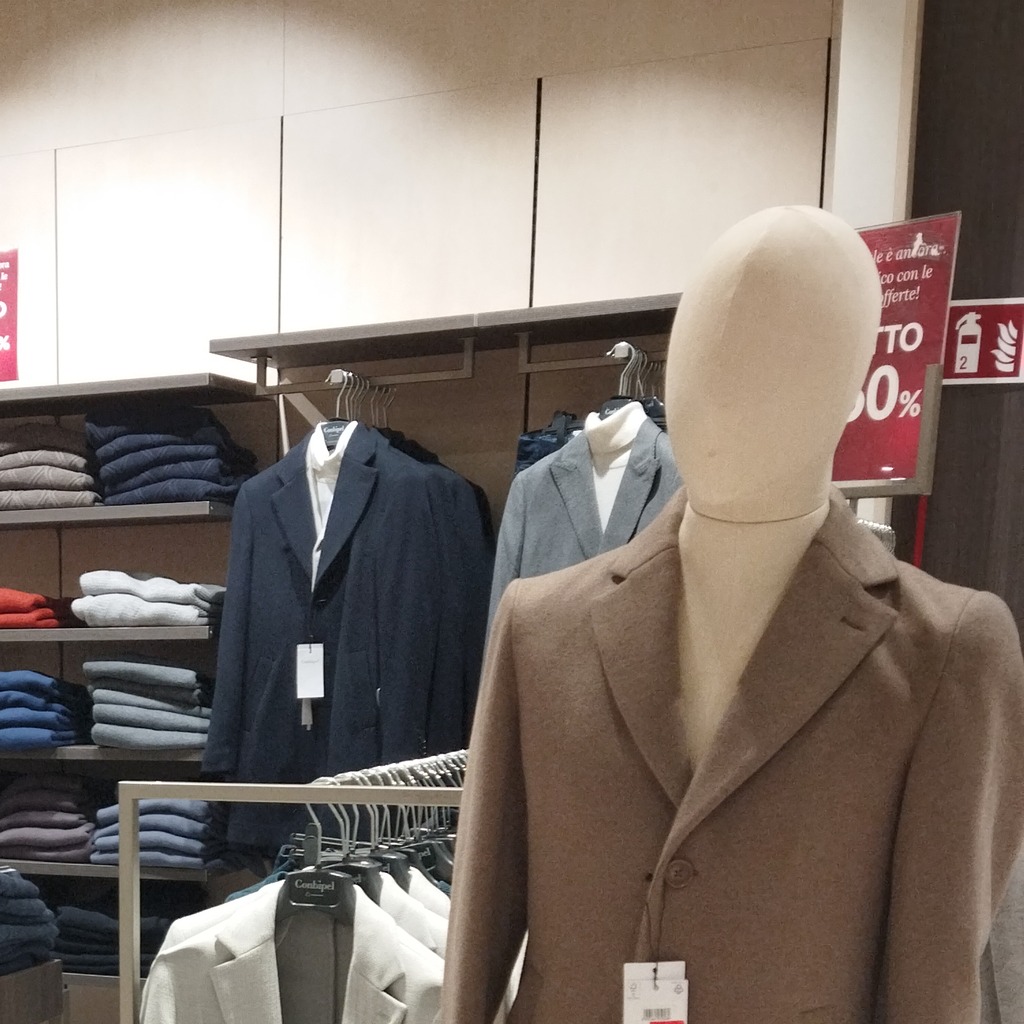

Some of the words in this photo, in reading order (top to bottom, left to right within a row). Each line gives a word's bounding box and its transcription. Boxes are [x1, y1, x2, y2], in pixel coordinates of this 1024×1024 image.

[896, 269, 918, 282] con
[921, 264, 933, 279] le
[959, 355, 968, 370] 2
[294, 879, 335, 892] Conbipel
